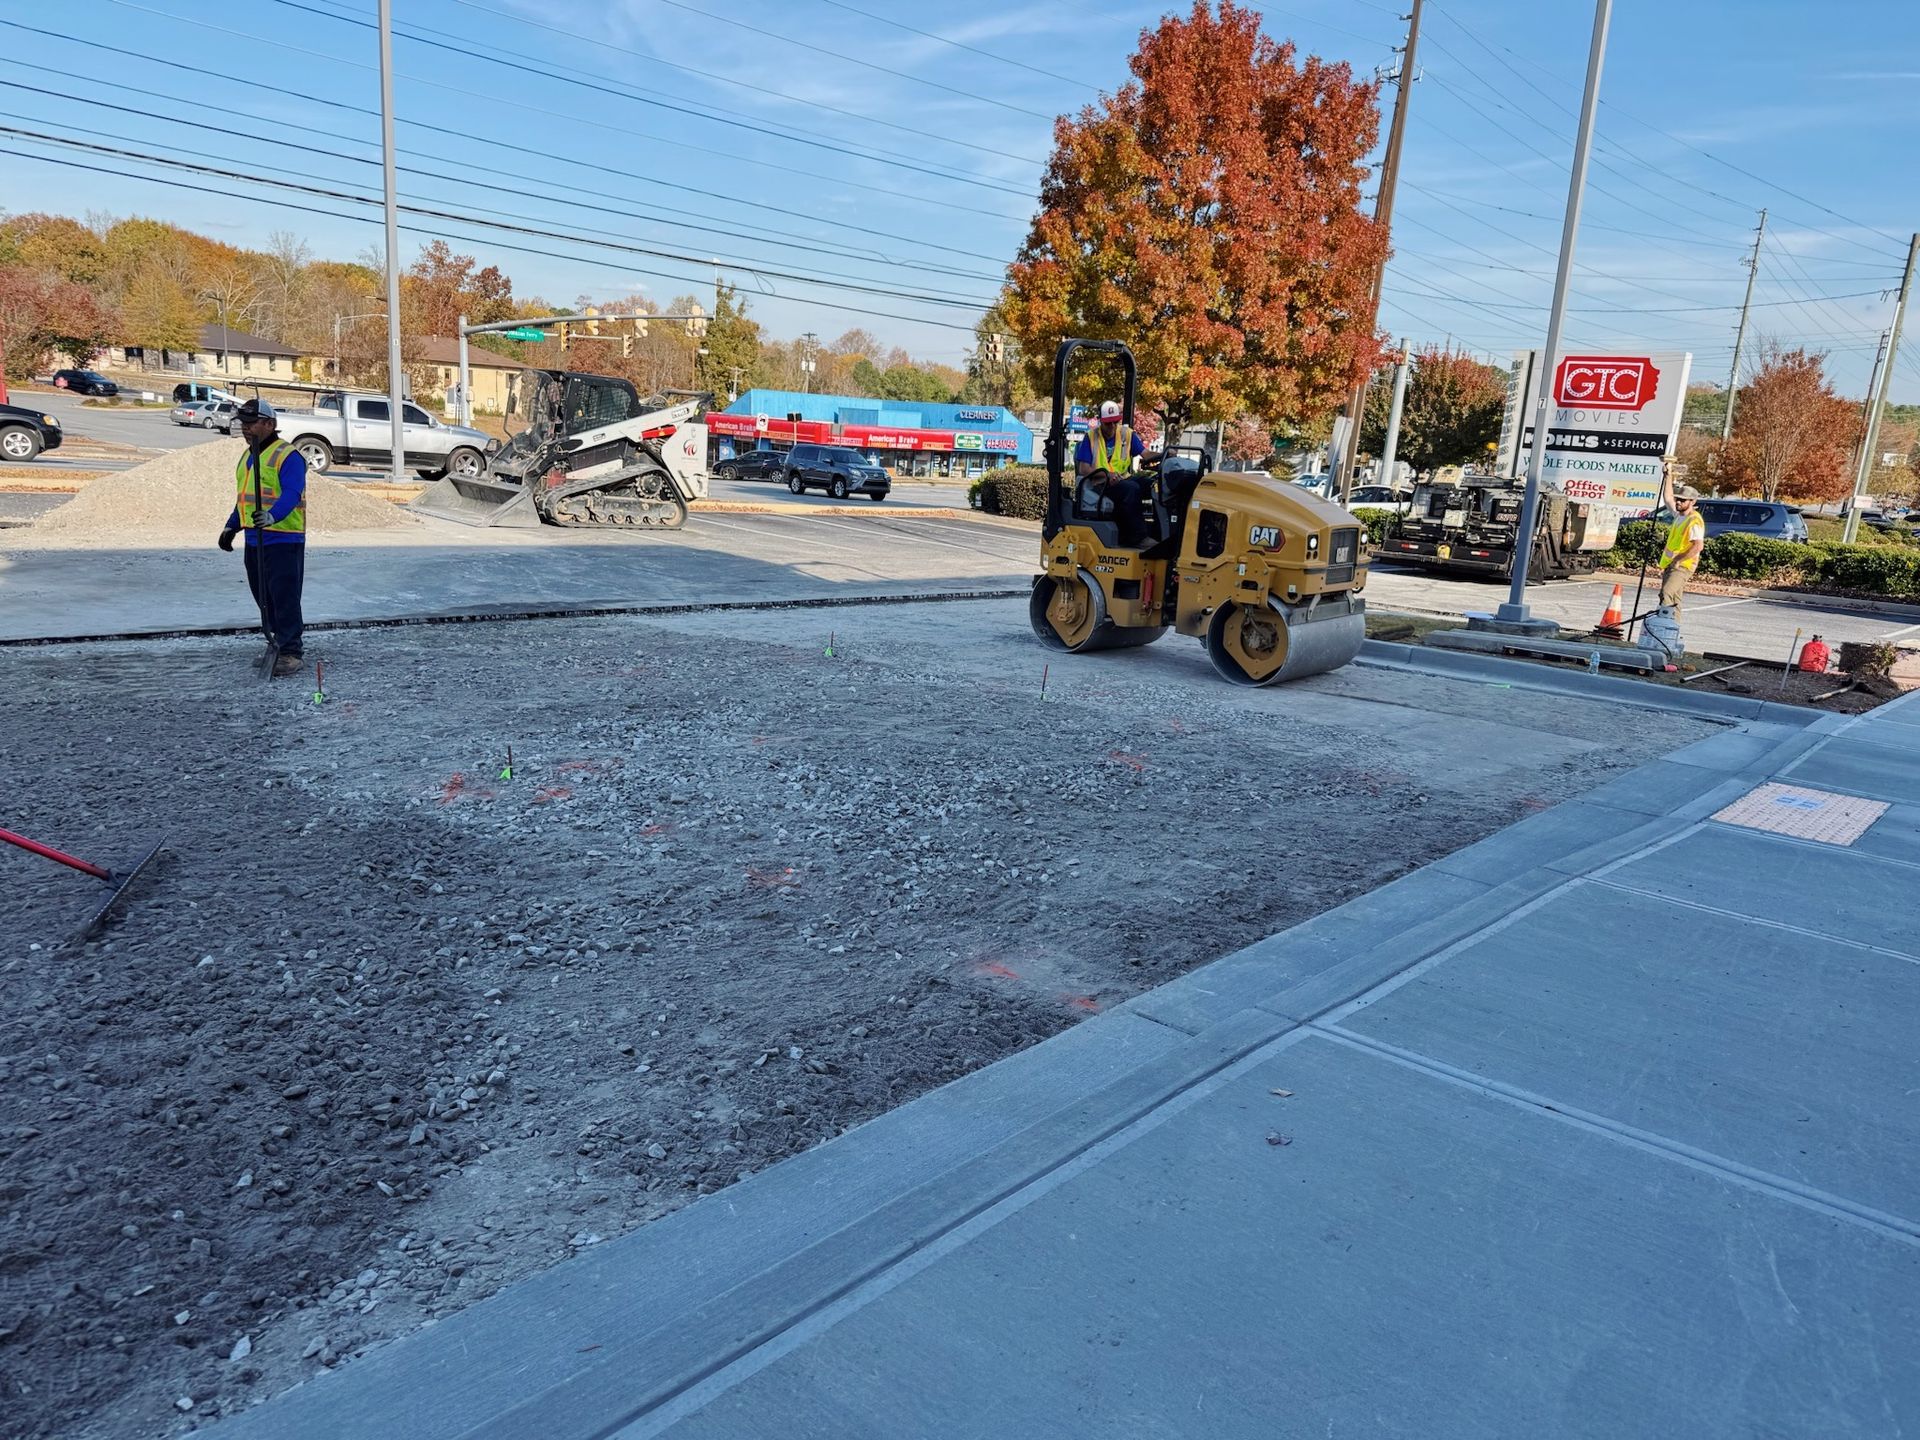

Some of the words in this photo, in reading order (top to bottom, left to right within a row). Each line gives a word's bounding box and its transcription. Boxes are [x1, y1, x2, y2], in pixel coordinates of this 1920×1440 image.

[1565, 367, 1639, 400] GTC
[1539, 398, 1545, 408] 7
[959, 409, 1000, 420] CLEANERS
[1555, 409, 1640, 426] MOVIES
[714, 421, 739, 431] American
[868, 434, 897, 443] American
[898, 435, 918, 444] Brake
[1523, 455, 1563, 468] WOLE
[1566, 459, 1605, 471] FOODS
[1608, 462, 1658, 475] MARKET
[1565, 479, 1606, 492] Office
[1565, 490, 1606, 499] DEPOT
[1251, 526, 1279, 548] CAT
[1098, 554, 1130, 567] YANCEY
[1336, 547, 1349, 563] CAT
